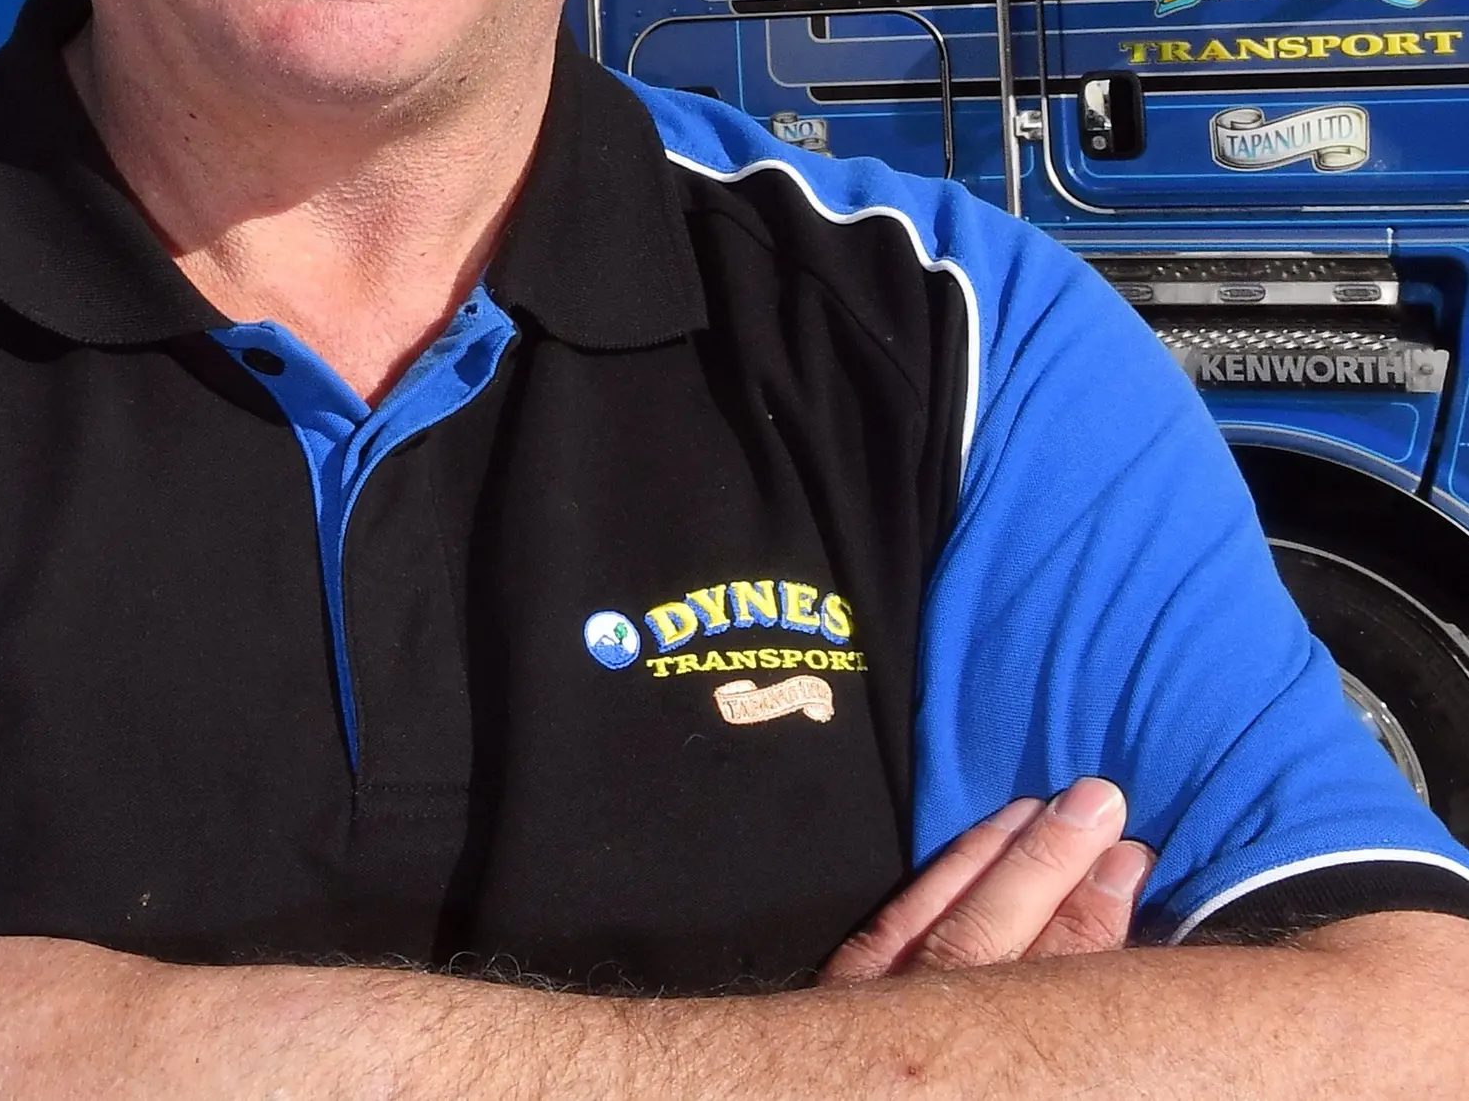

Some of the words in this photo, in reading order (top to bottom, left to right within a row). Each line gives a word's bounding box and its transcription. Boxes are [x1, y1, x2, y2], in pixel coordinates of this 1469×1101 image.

[1119, 30, 1463, 65] TRANSPORT
[1226, 121, 1311, 158] TAPANUI
[1200, 353, 1406, 384] KENWORTH
[644, 580, 852, 653] DYNES
[646, 648, 868, 678] TRANSPORT
